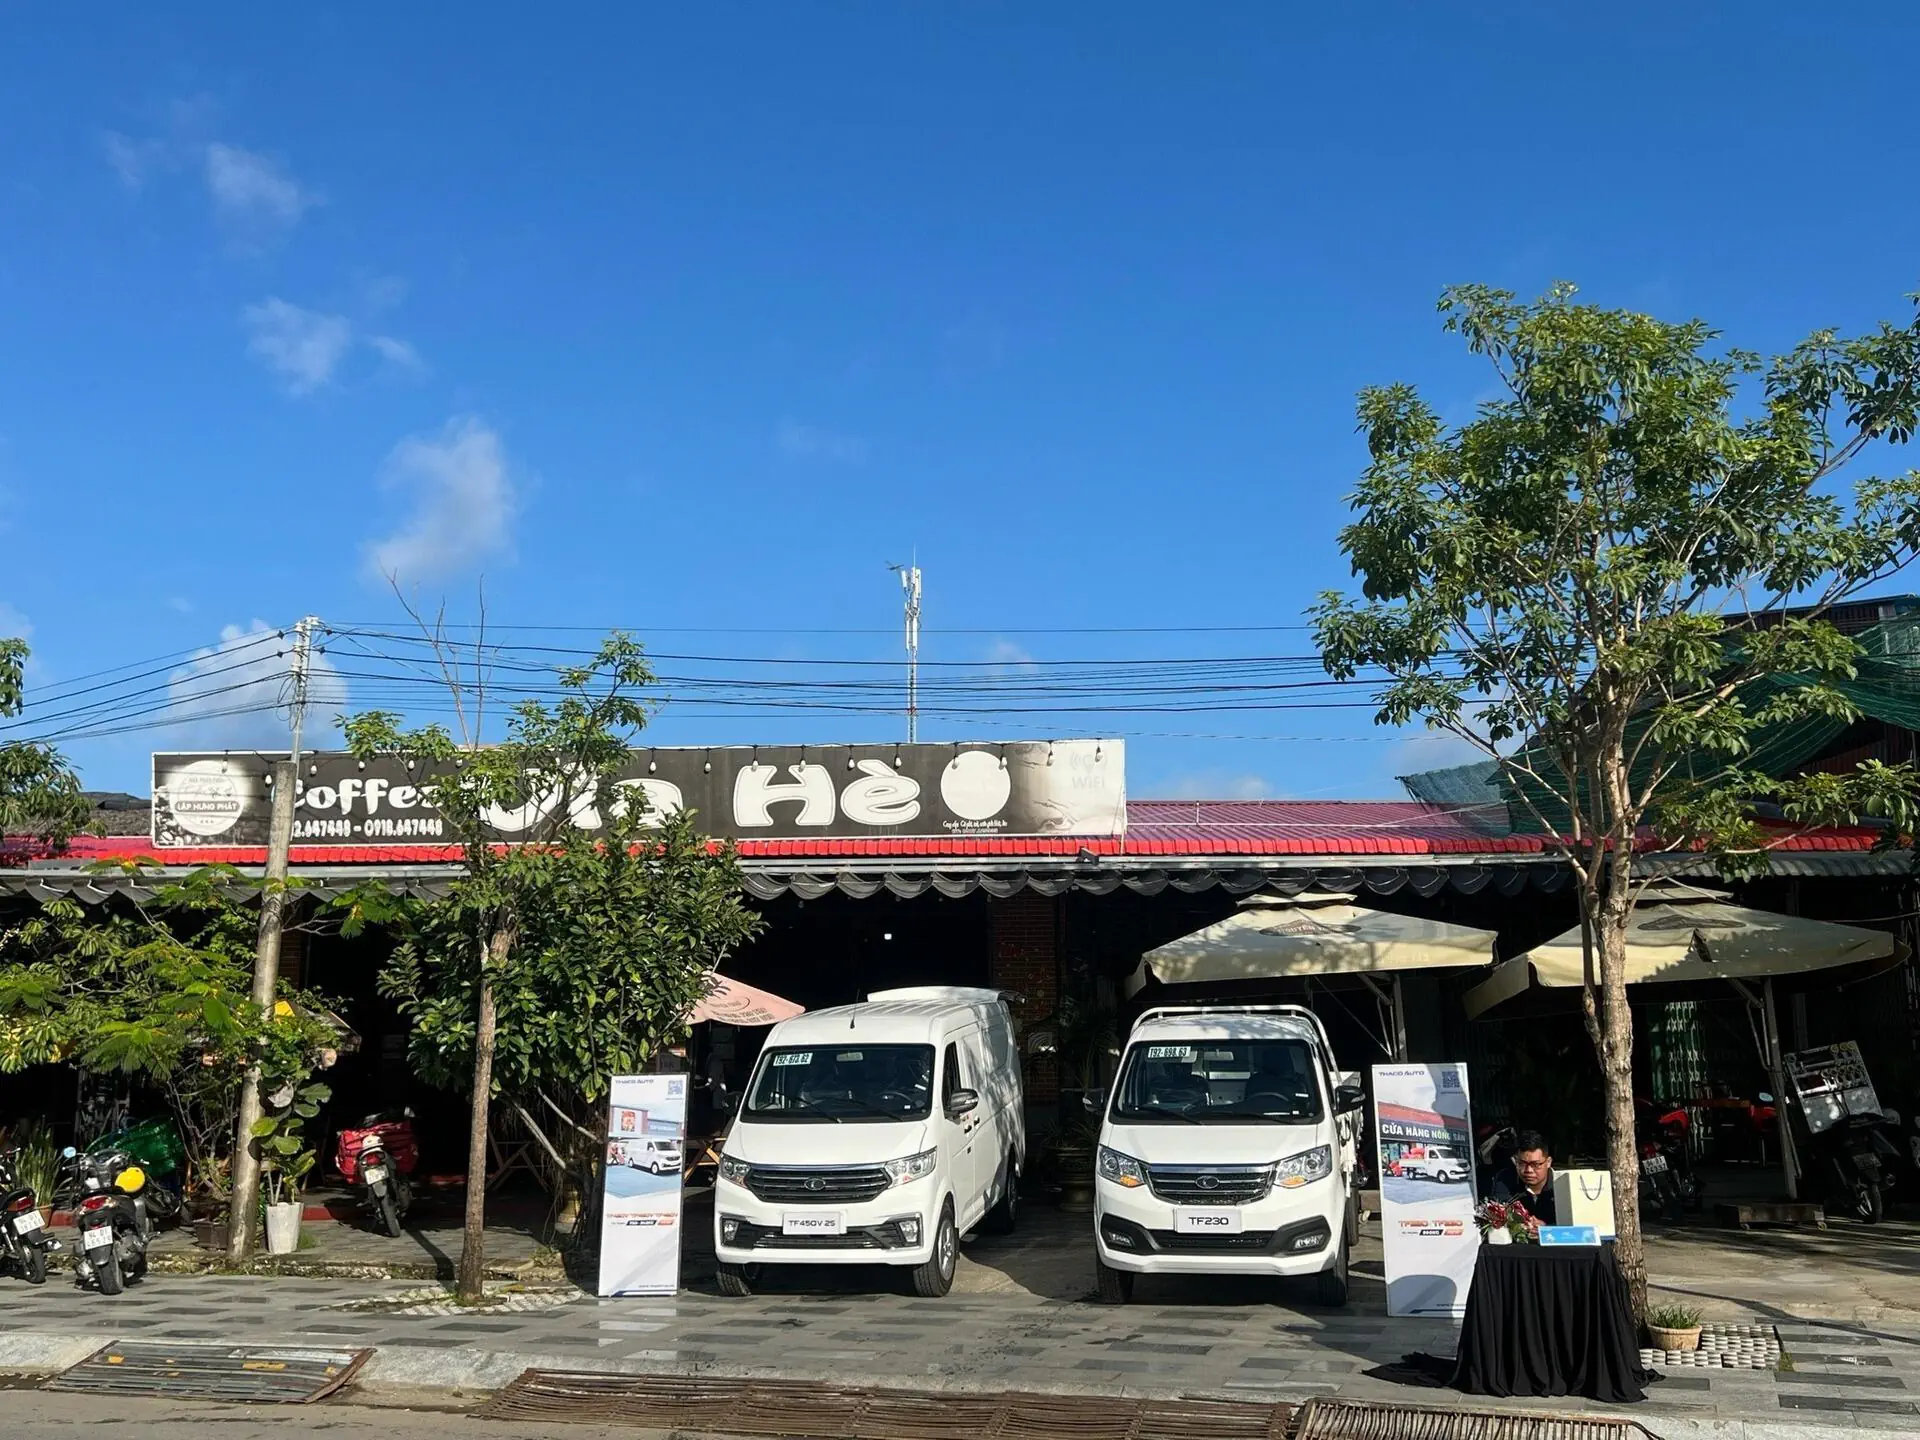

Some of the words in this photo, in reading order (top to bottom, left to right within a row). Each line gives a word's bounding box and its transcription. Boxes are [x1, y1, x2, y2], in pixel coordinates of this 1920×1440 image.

[733, 759, 921, 827] Hè
[1382, 1122, 1404, 1136] CỬA
[1405, 1126, 1430, 1139] HÀNG
[788, 1219, 824, 1227] TF450V
[1188, 1216, 1230, 1226] TF230
